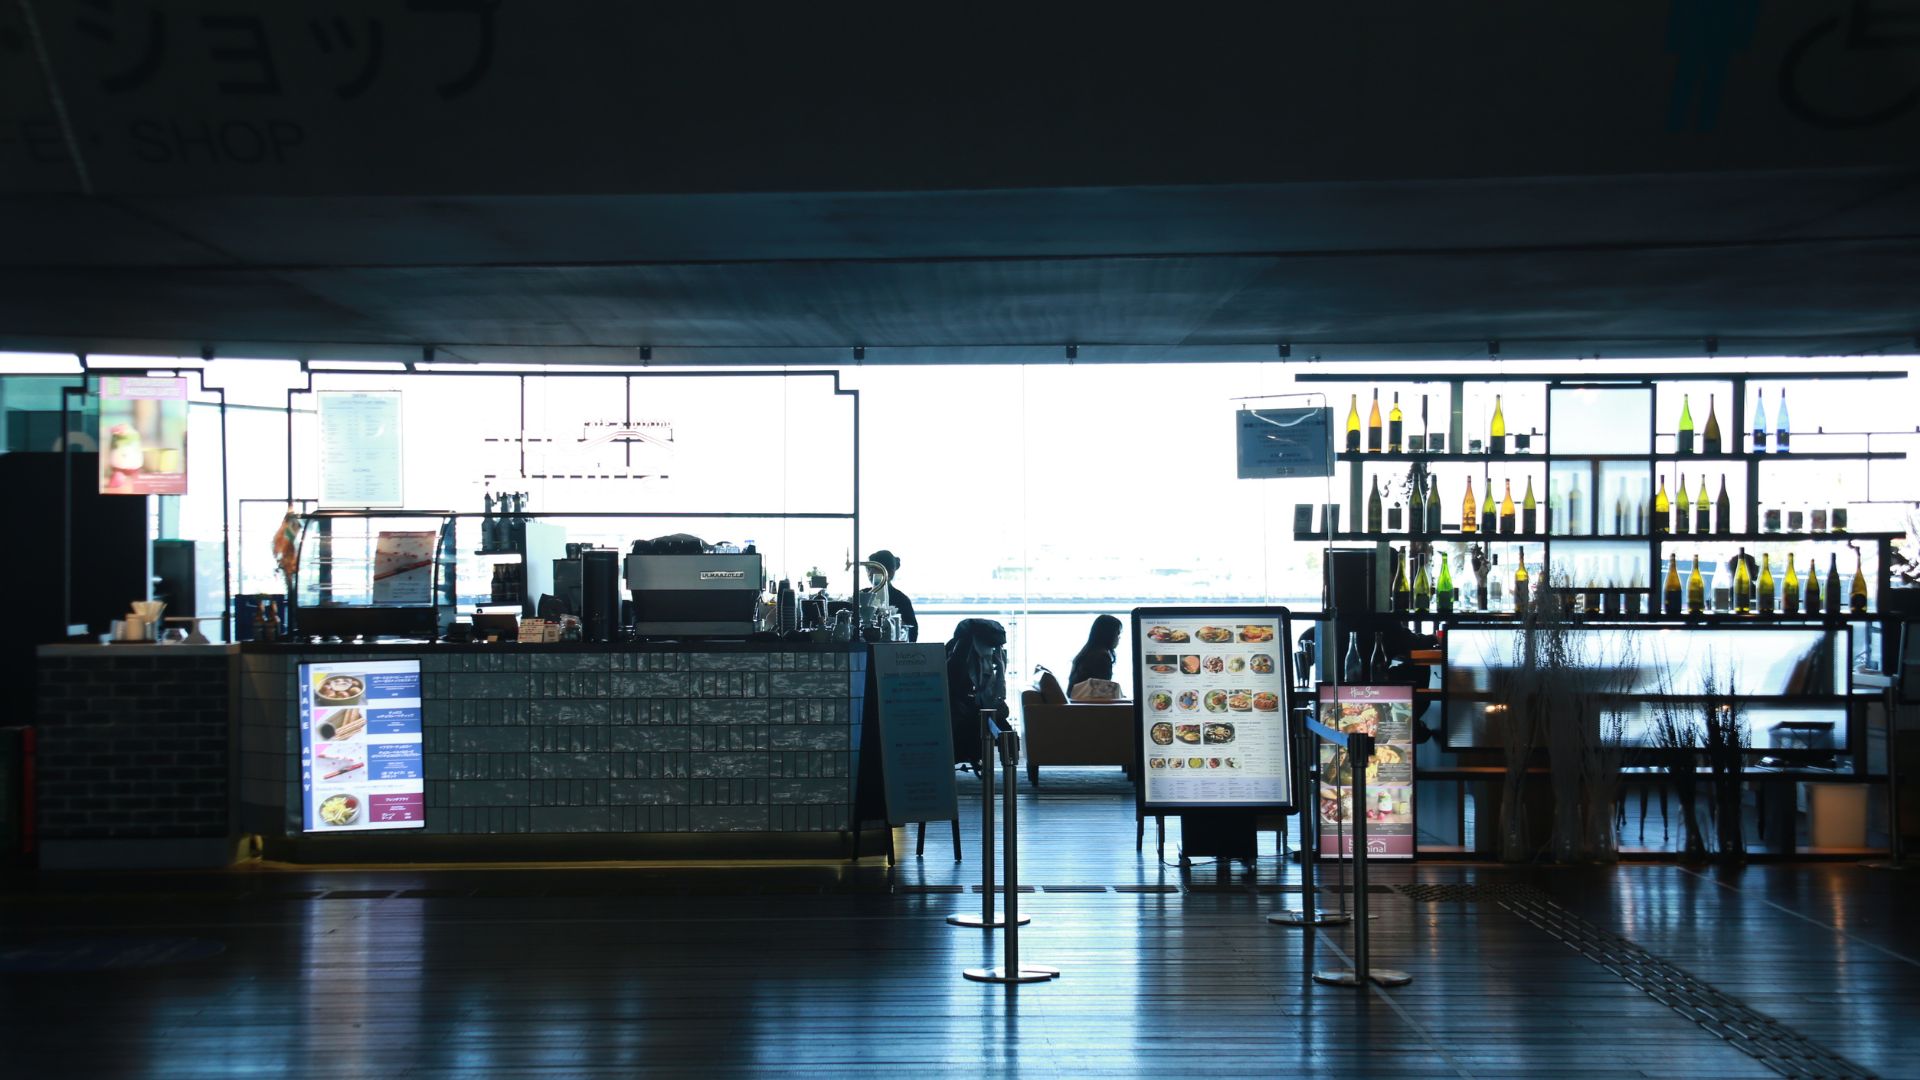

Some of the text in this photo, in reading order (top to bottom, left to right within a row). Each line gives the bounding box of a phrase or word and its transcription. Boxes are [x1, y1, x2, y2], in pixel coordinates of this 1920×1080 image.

[128, 119, 305, 165] SHOP
[302, 684, 312, 792] TAKE AWAY
